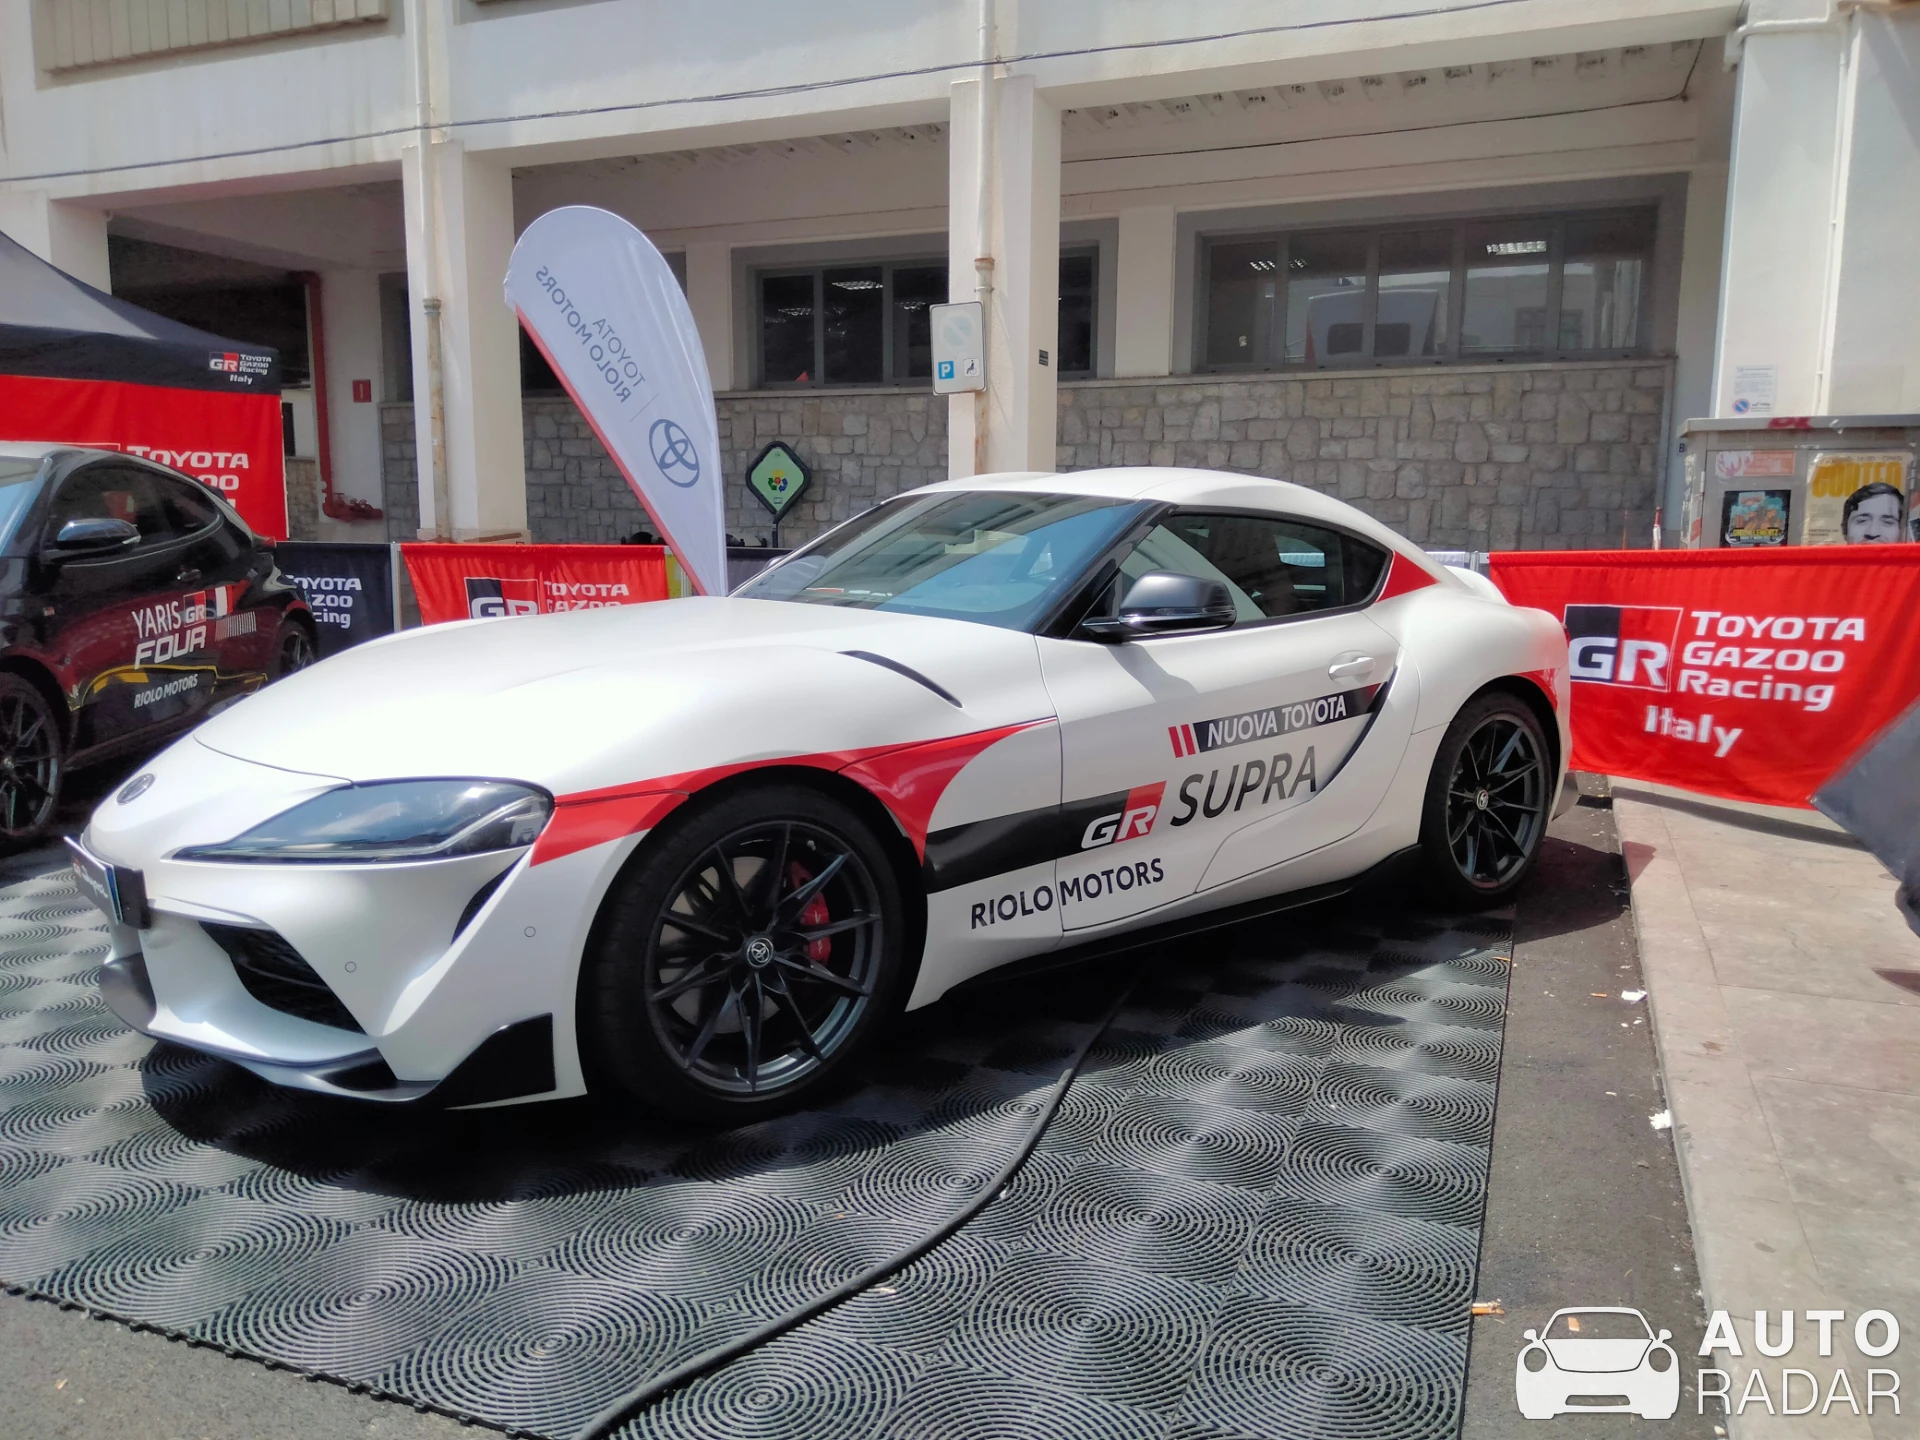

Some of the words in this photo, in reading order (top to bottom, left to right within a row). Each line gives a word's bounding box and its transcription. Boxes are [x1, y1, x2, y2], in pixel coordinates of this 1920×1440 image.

[210, 358, 238, 372] GR
[239, 366, 268, 375] Racing
[240, 354, 272, 362] TOYOTA
[230, 374, 253, 385] Italy
[311, 594, 353, 608] ZOO
[131, 601, 181, 639] YARIS
[185, 604, 206, 624] GR
[1691, 611, 1865, 641] TOYOTA
[134, 625, 207, 670] FOUR
[1568, 637, 1668, 687] GR
[1682, 641, 1845, 672] GAZOO
[134, 687, 162, 709] RIOLO
[163, 673, 199, 699] MOTORS
[1677, 670, 1835, 712] Racing
[1207, 711, 1278, 748] NUOVA
[1282, 695, 1347, 734] TOYOTA
[1644, 705, 1743, 758] Italy
[1080, 805, 1158, 850] GR
[1170, 745, 1318, 828] SUPRA
[971, 884, 1054, 930] RIOLO
[1060, 857, 1164, 906] MOTORS
